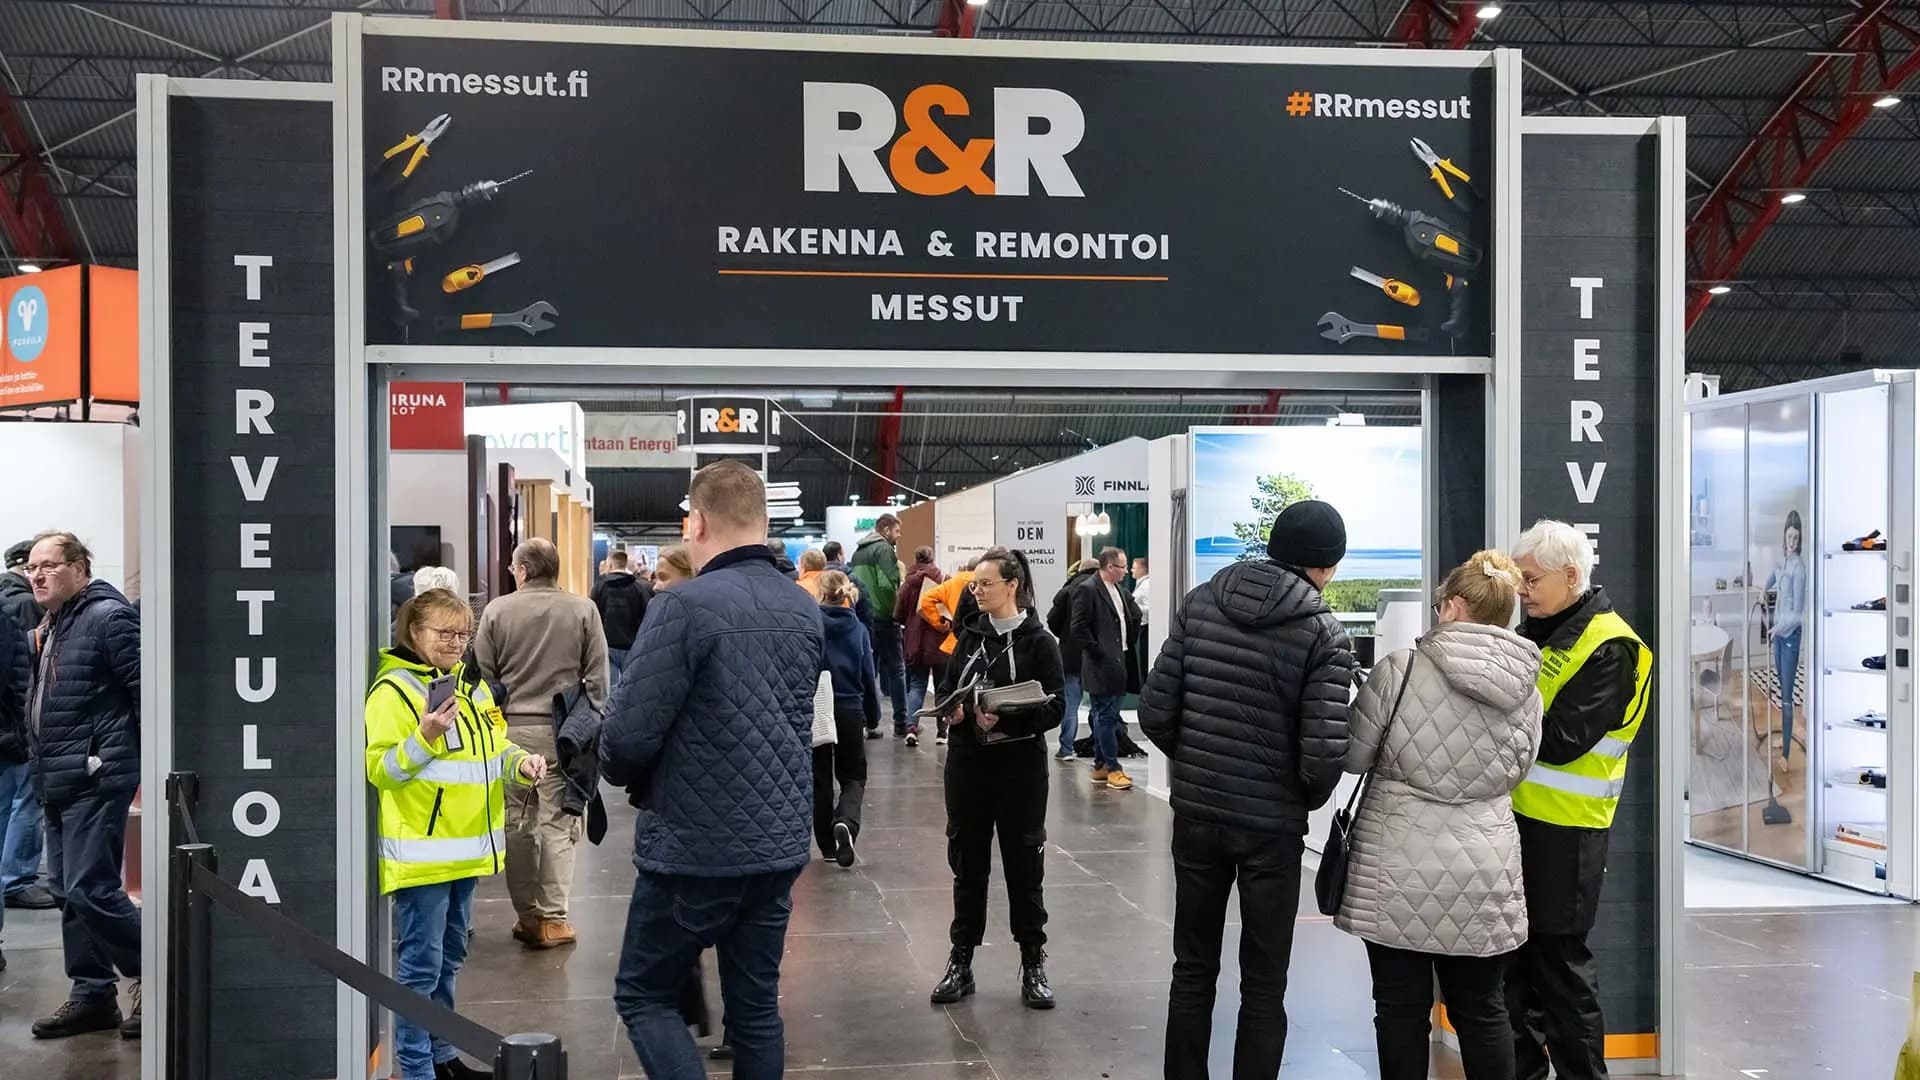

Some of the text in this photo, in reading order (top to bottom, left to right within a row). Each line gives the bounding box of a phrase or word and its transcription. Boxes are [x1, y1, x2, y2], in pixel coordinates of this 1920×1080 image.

[382, 66, 588, 98] RRmessut.fi
[1287, 91, 1471, 120] #RRmessut
[803, 81, 1086, 197] R&R
[718, 226, 1169, 261] RAKENNA & REMONTOI
[871, 293, 1024, 322] MESSUT
[392, 393, 447, 407] IRUNA
[392, 406, 416, 415] LOT
[700, 407, 759, 433] R&R
[1566, 277, 1607, 588] TERVE
[1103, 480, 1149, 491] FINNL
[1017, 527, 1044, 540] DEN
[230, 255, 281, 904] TERVETULOA
